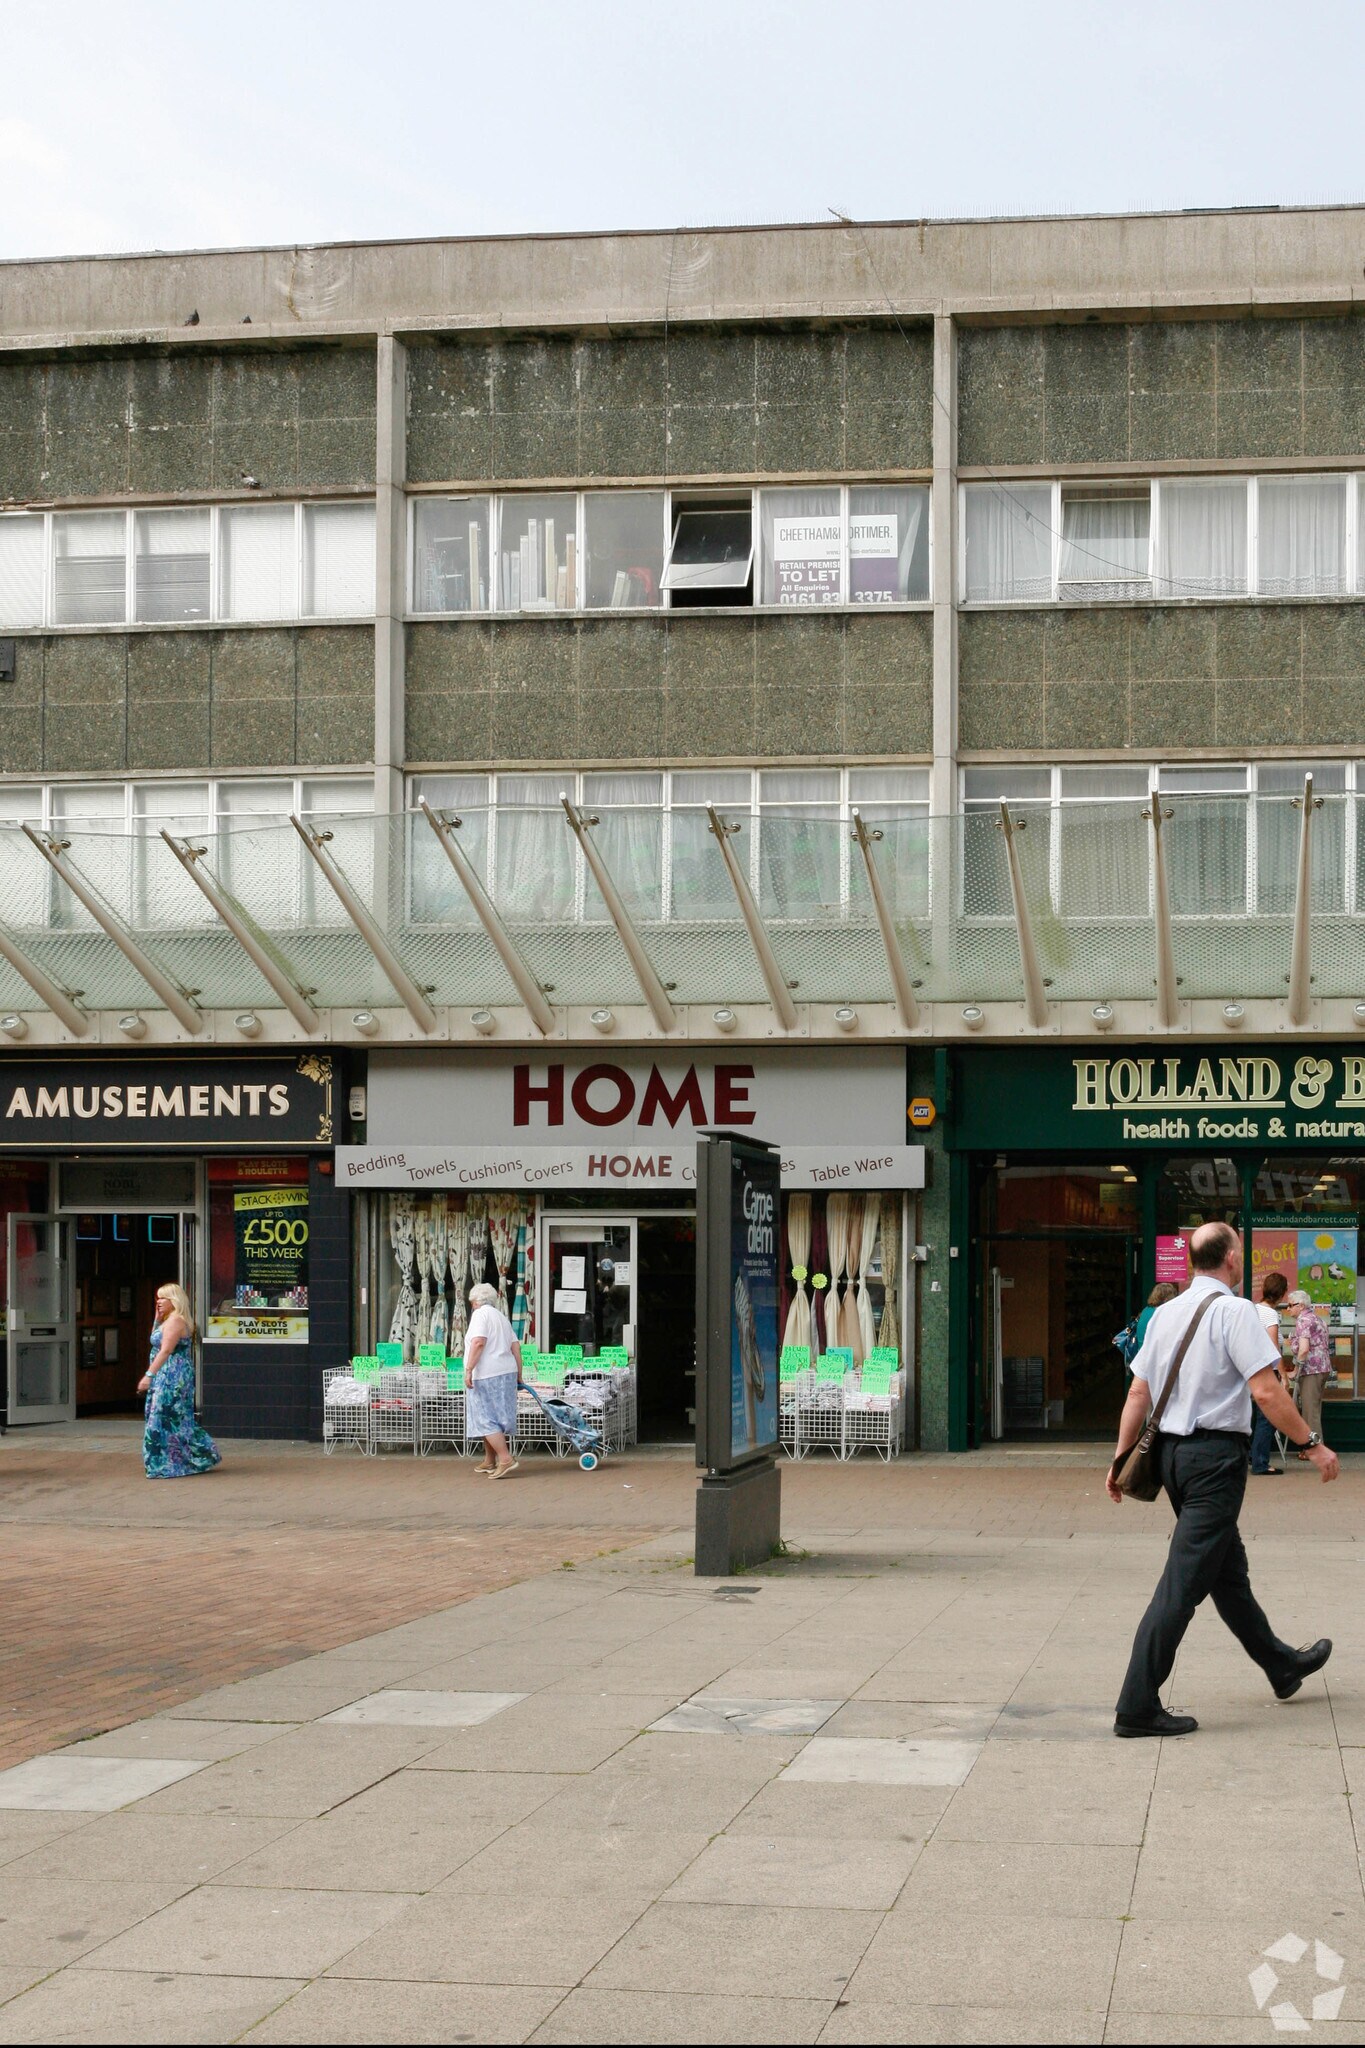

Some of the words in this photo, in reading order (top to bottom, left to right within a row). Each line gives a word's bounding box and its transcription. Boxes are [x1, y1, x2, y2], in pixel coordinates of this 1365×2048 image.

[780, 562, 806, 570] RETAIL
[780, 571, 802, 582] TO
[808, 570, 839, 582] LET
[780, 593, 815, 603] 0161
[855, 591, 893, 602] 3375
[794, 584, 830, 592] Enquiries
[1072, 1057, 1281, 1110] HOLLAND
[1290, 1056, 1333, 1109] &
[6, 1084, 290, 1118] AMUSEMENTS
[513, 1063, 757, 1129] HOME
[914, 1106, 929, 1117] ADT
[1123, 1118, 1190, 1138] health
[1197, 1117, 1258, 1138] foods
[1267, 1117, 1287, 1137] &
[347, 1153, 407, 1177] Bedding
[406, 1159, 457, 1182] Towels
[458, 1157, 523, 1183] Cushions
[524, 1161, 574, 1182] Covers
[588, 1155, 673, 1177] HOME
[809, 1165, 850, 1182] Table
[855, 1156, 894, 1173] Ware
[241, 1195, 273, 1206] STACK
[285, 1192, 309, 1202] WIN
[743, 1181, 774, 1225] Carpe
[243, 1219, 309, 1245] £500
[748, 1222, 773, 1254] diem
[245, 1247, 268, 1258] THIS
[270, 1247, 304, 1259] WEEK
[1272, 1242, 1295, 1263] off
